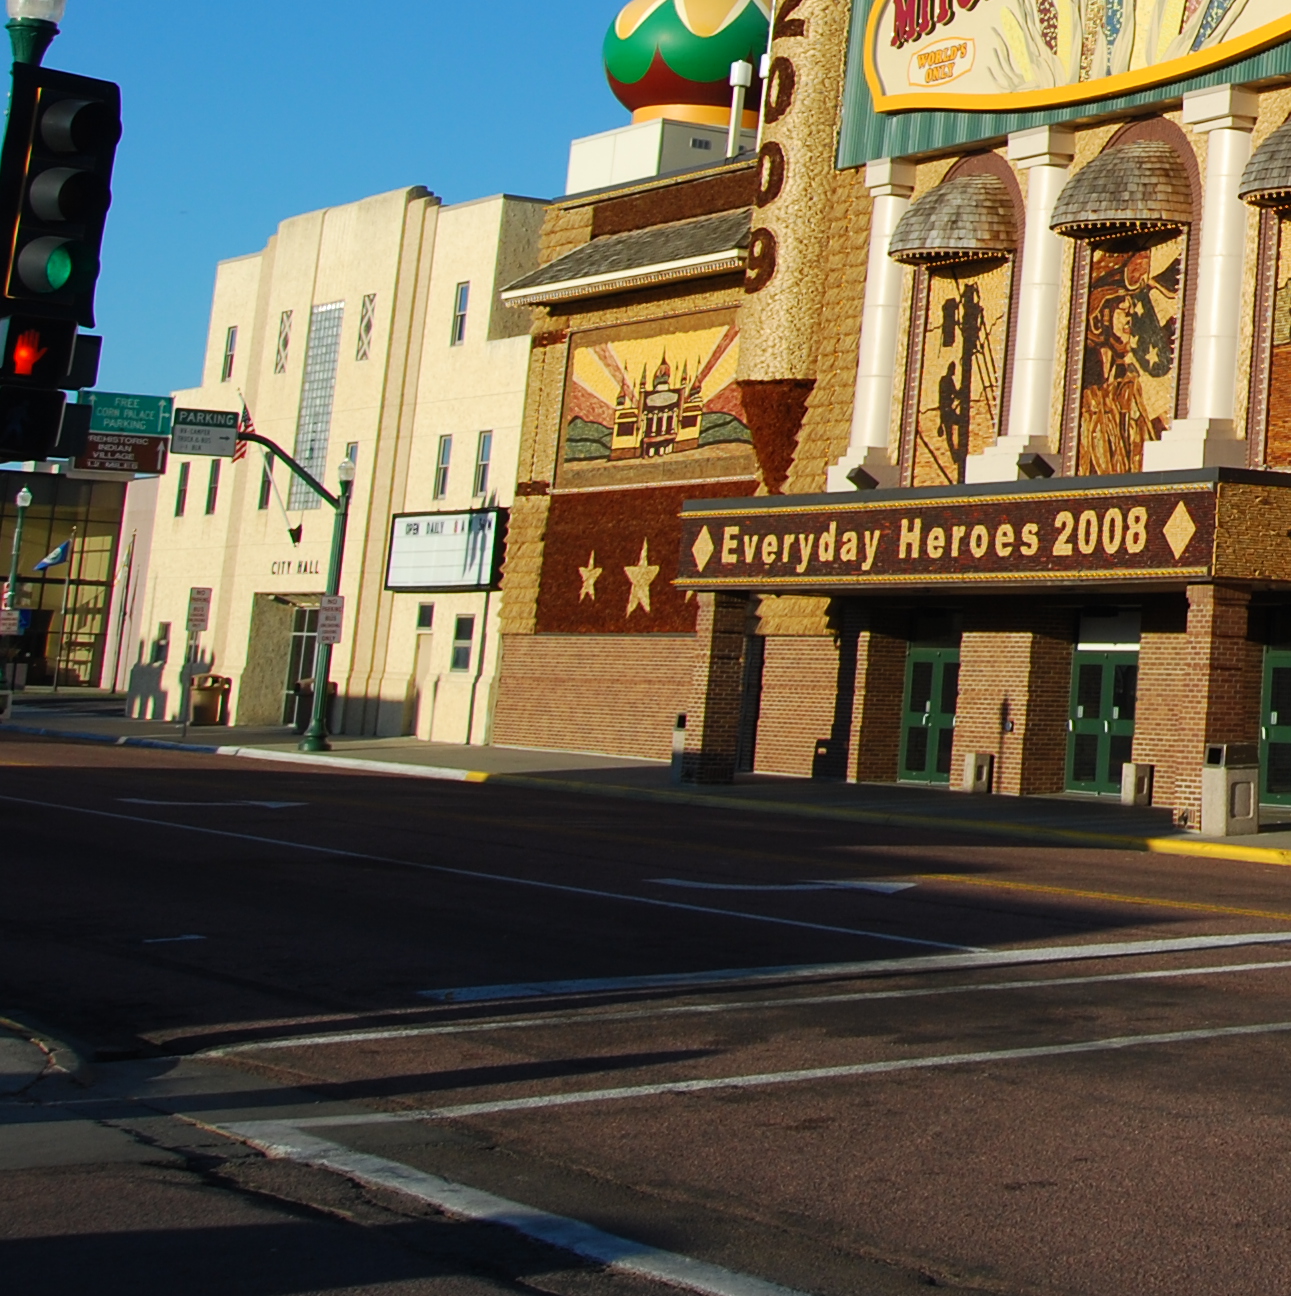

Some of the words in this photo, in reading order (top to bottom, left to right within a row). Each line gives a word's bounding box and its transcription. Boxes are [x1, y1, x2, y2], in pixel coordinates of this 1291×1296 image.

[916, 42, 968, 69] WORLD'S
[924, 61, 956, 83] ONLY
[114, 397, 140, 408] FREE
[96, 407, 120, 417] CORN
[123, 409, 155, 420] PALACE
[179, 411, 234, 426] PARKING
[103, 418, 147, 430] PARKING
[98, 444, 132, 452] INDIAN
[92, 451, 135, 460] VILLAGE
[105, 461, 138, 470] MILES
[426, 521, 445, 534] DAILY
[721, 520, 881, 573] Everyday
[898, 517, 1039, 558] Heroes
[1052, 506, 1148, 556] 2008
[271, 560, 293, 575] CITY
[297, 559, 319, 575] HALL
